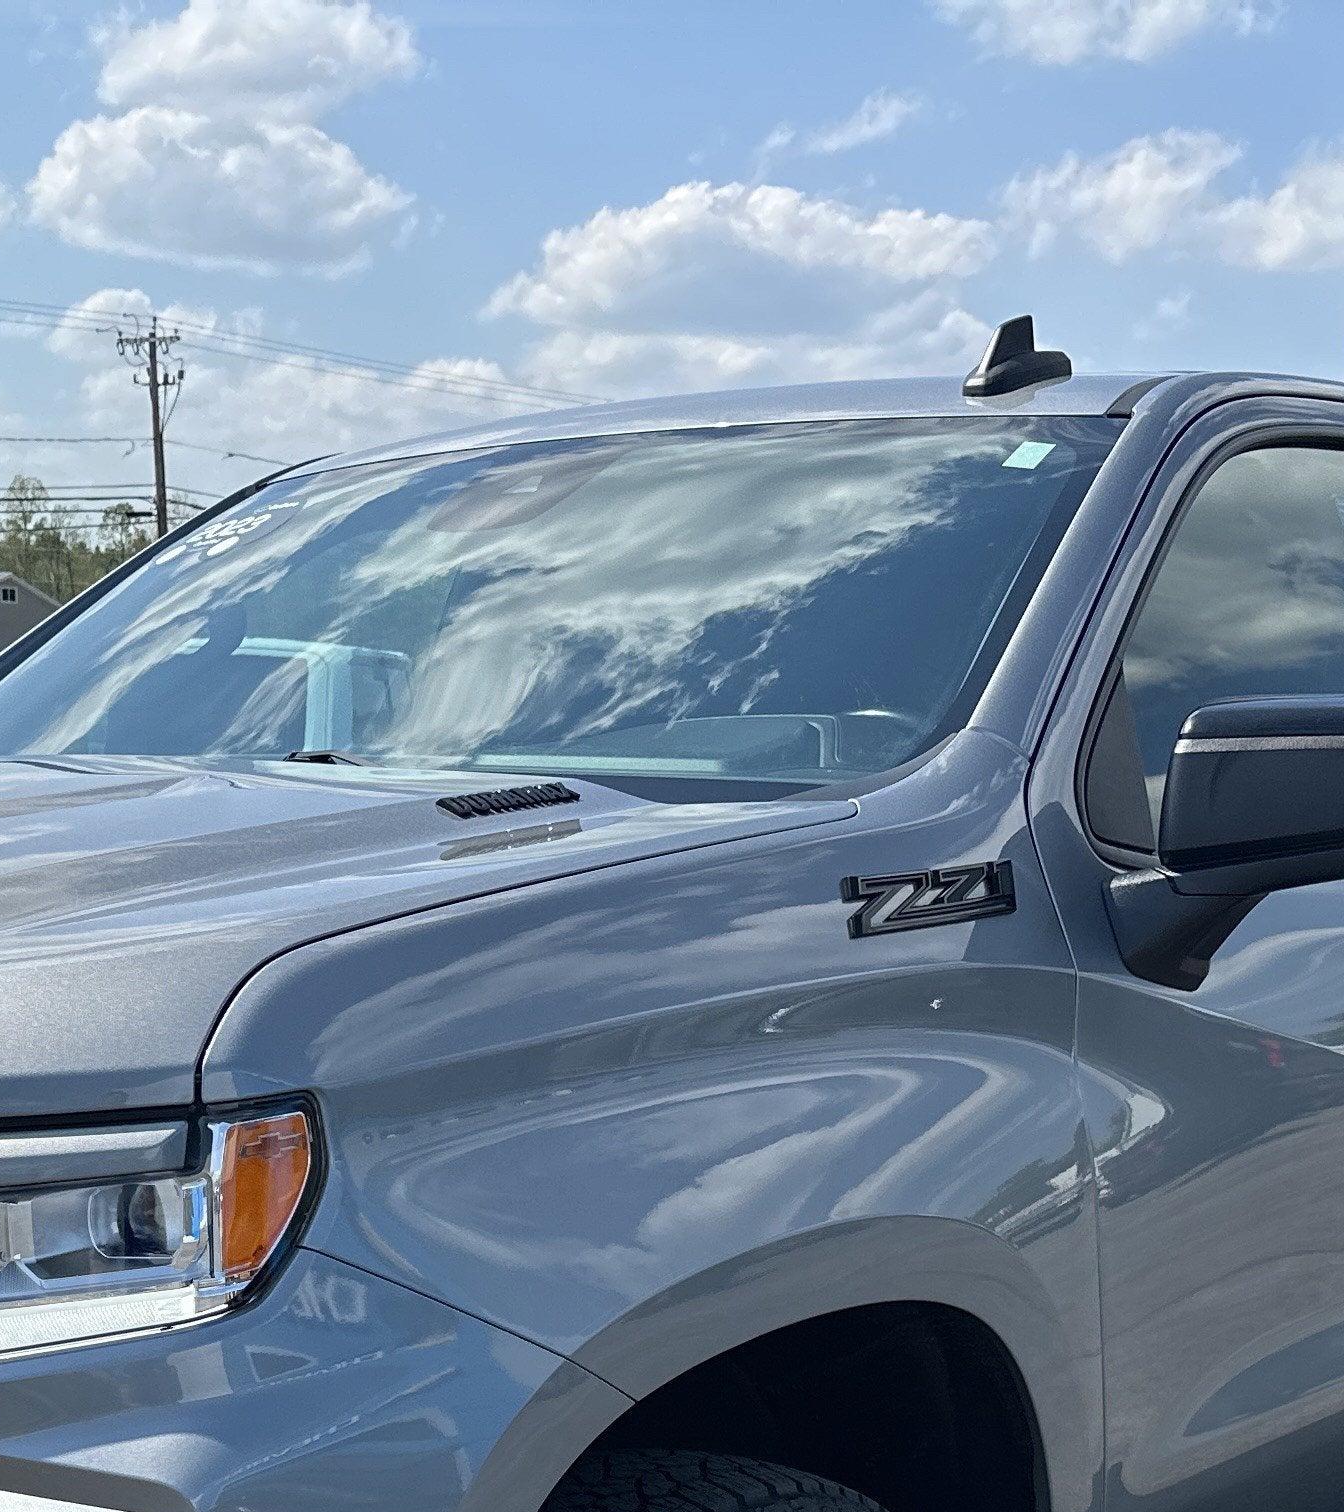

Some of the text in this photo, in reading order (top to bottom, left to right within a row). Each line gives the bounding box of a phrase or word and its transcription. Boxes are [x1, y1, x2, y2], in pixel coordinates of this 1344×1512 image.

[186, 513, 272, 544] 2023
[435, 781, 581, 820] DURAMAX
[840, 859, 1017, 940] Z71
